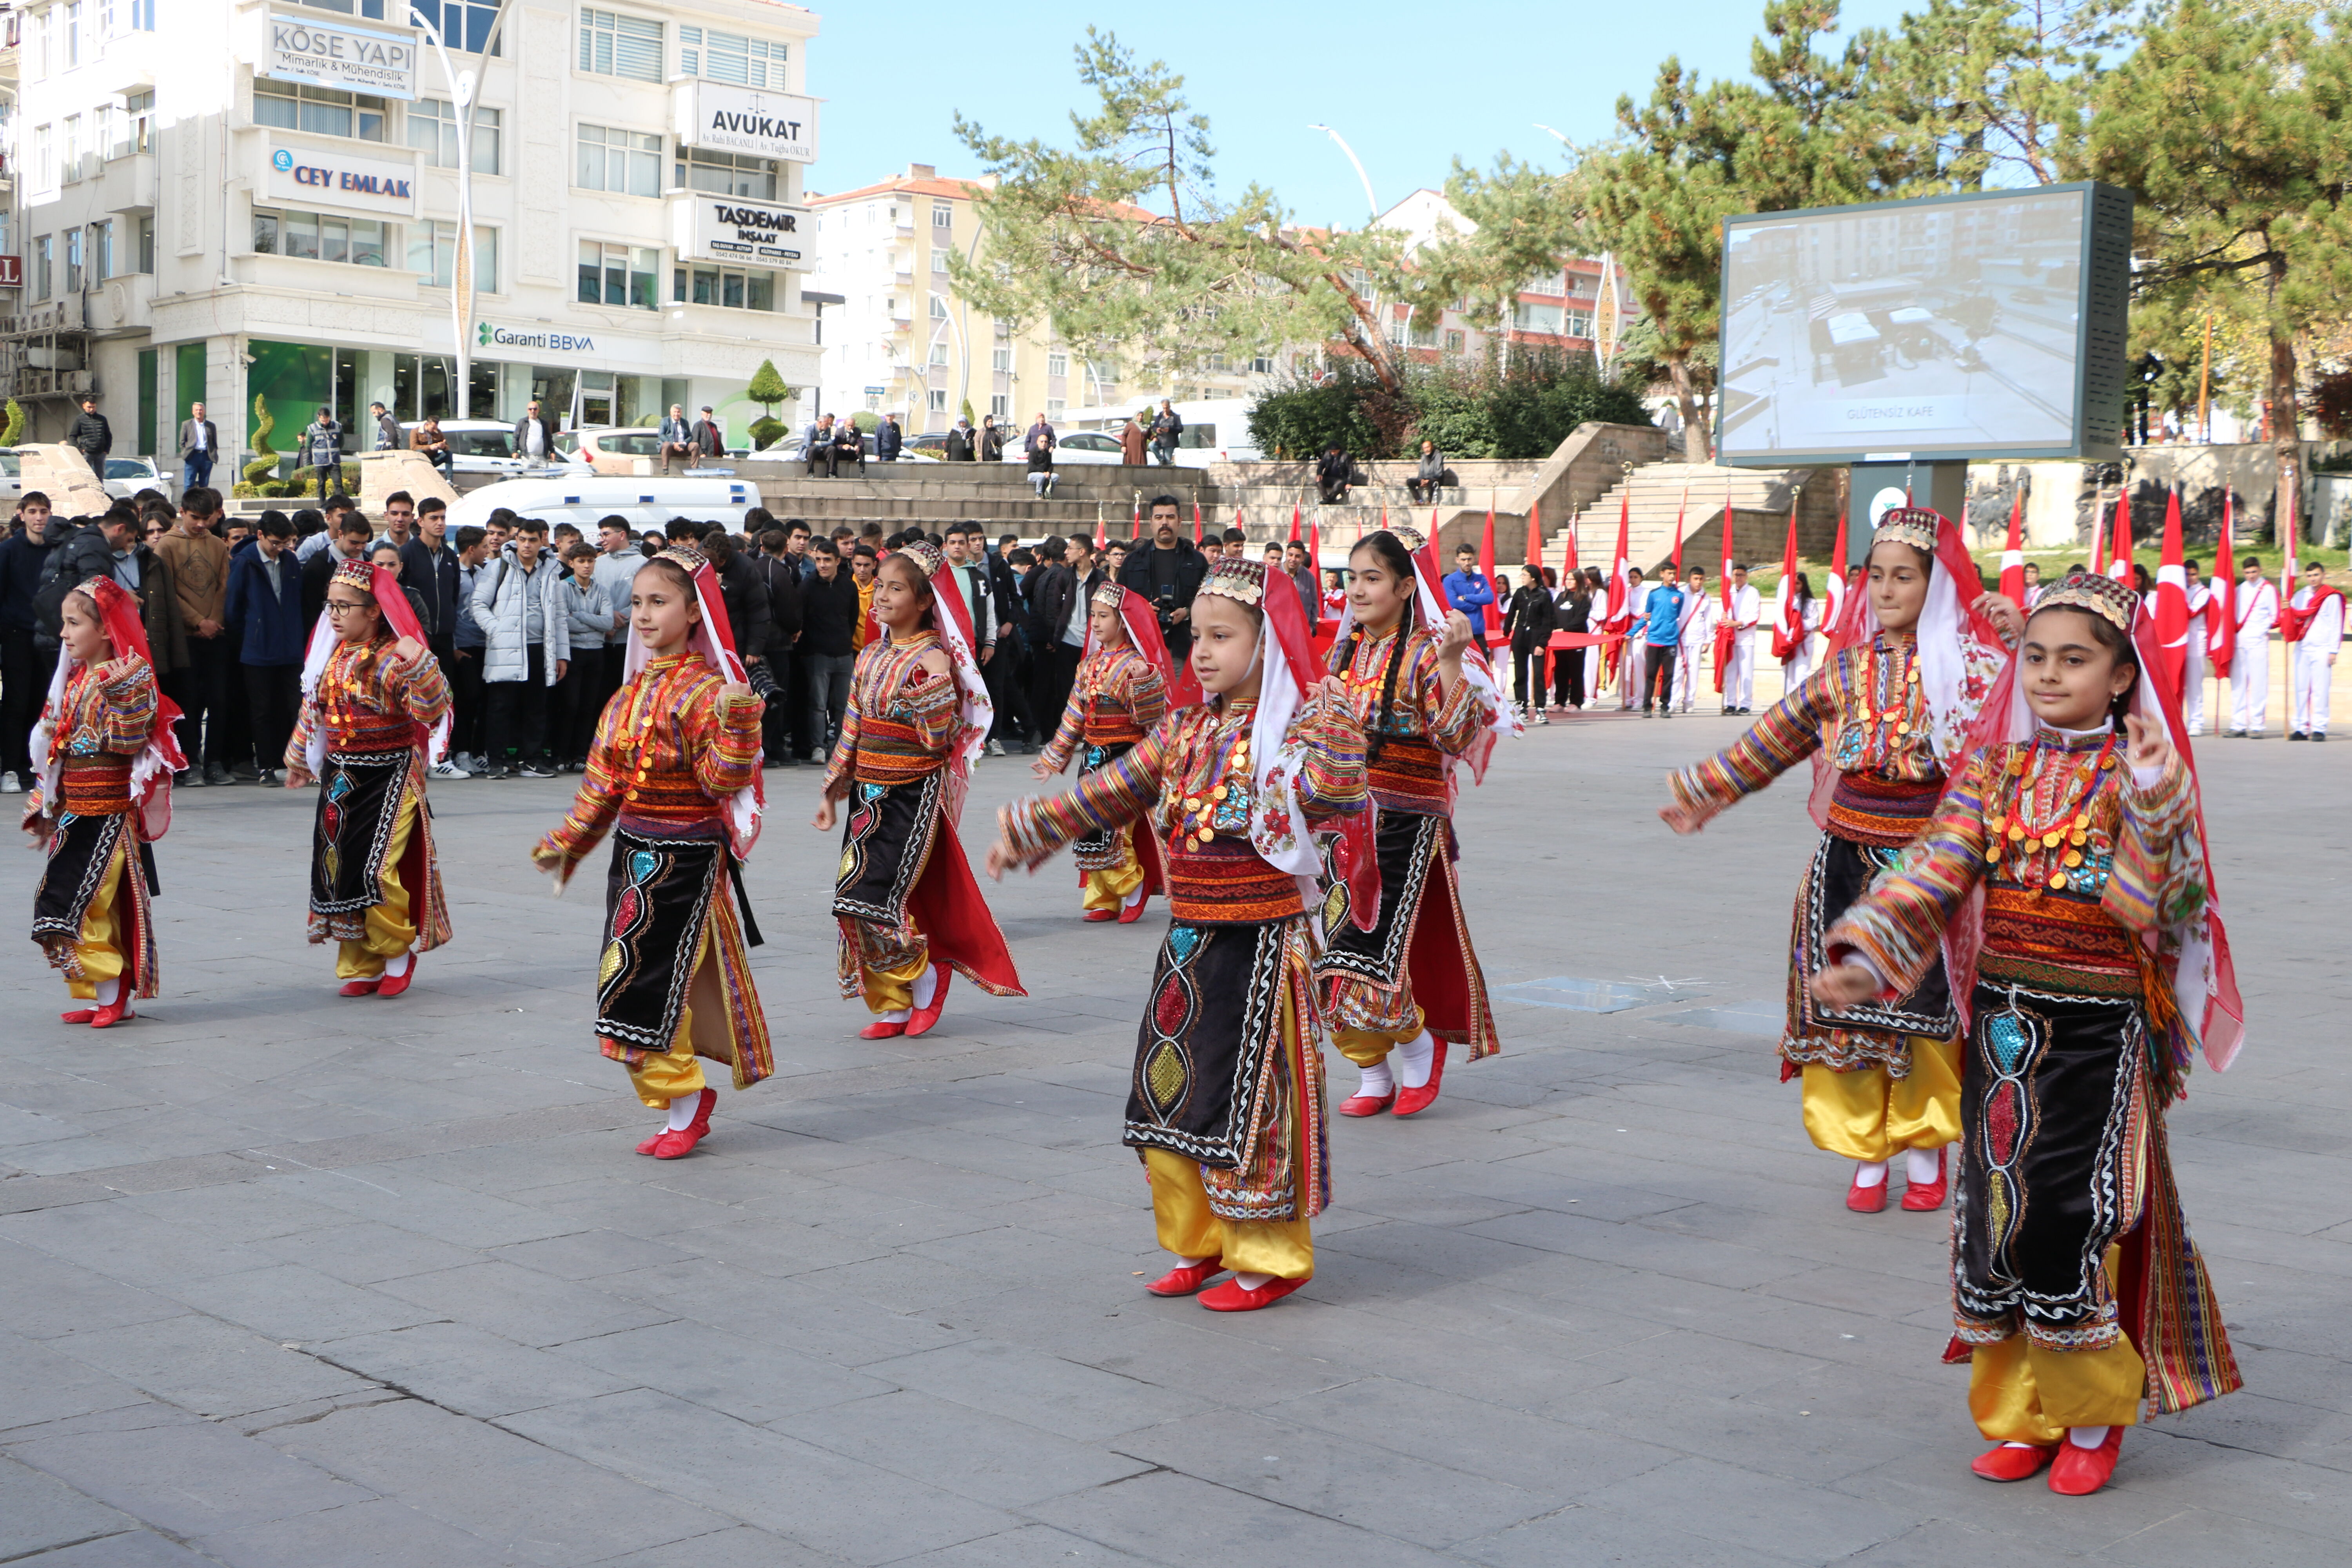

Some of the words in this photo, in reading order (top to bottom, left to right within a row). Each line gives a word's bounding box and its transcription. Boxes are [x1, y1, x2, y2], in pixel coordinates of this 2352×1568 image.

[274, 25, 344, 59] KÖSE
[354, 40, 410, 70] YAPI
[282, 53, 327, 69] Mimarlık
[331, 62, 338, 71] &
[342, 63, 403, 82] Mühendislik
[307, 68, 320, 76] KÖSE
[712, 110, 801, 141] AVUKAT
[702, 133, 711, 142] Av.
[712, 134, 725, 144] Ruhi
[726, 136, 753, 149] BACANLI
[759, 142, 769, 151] Av.
[770, 142, 789, 155] Tuğba
[790, 145, 810, 156] OKUR
[295, 165, 333, 187] CEY
[341, 172, 410, 198] EMLAK
[0, 260, 19, 282] L
[495, 328, 546, 347] Garanti
[550, 334, 594, 350] BBVA
[1847, 405, 1904, 419] GLÜTENSİZ
[1907, 406, 1934, 417] KAFE
